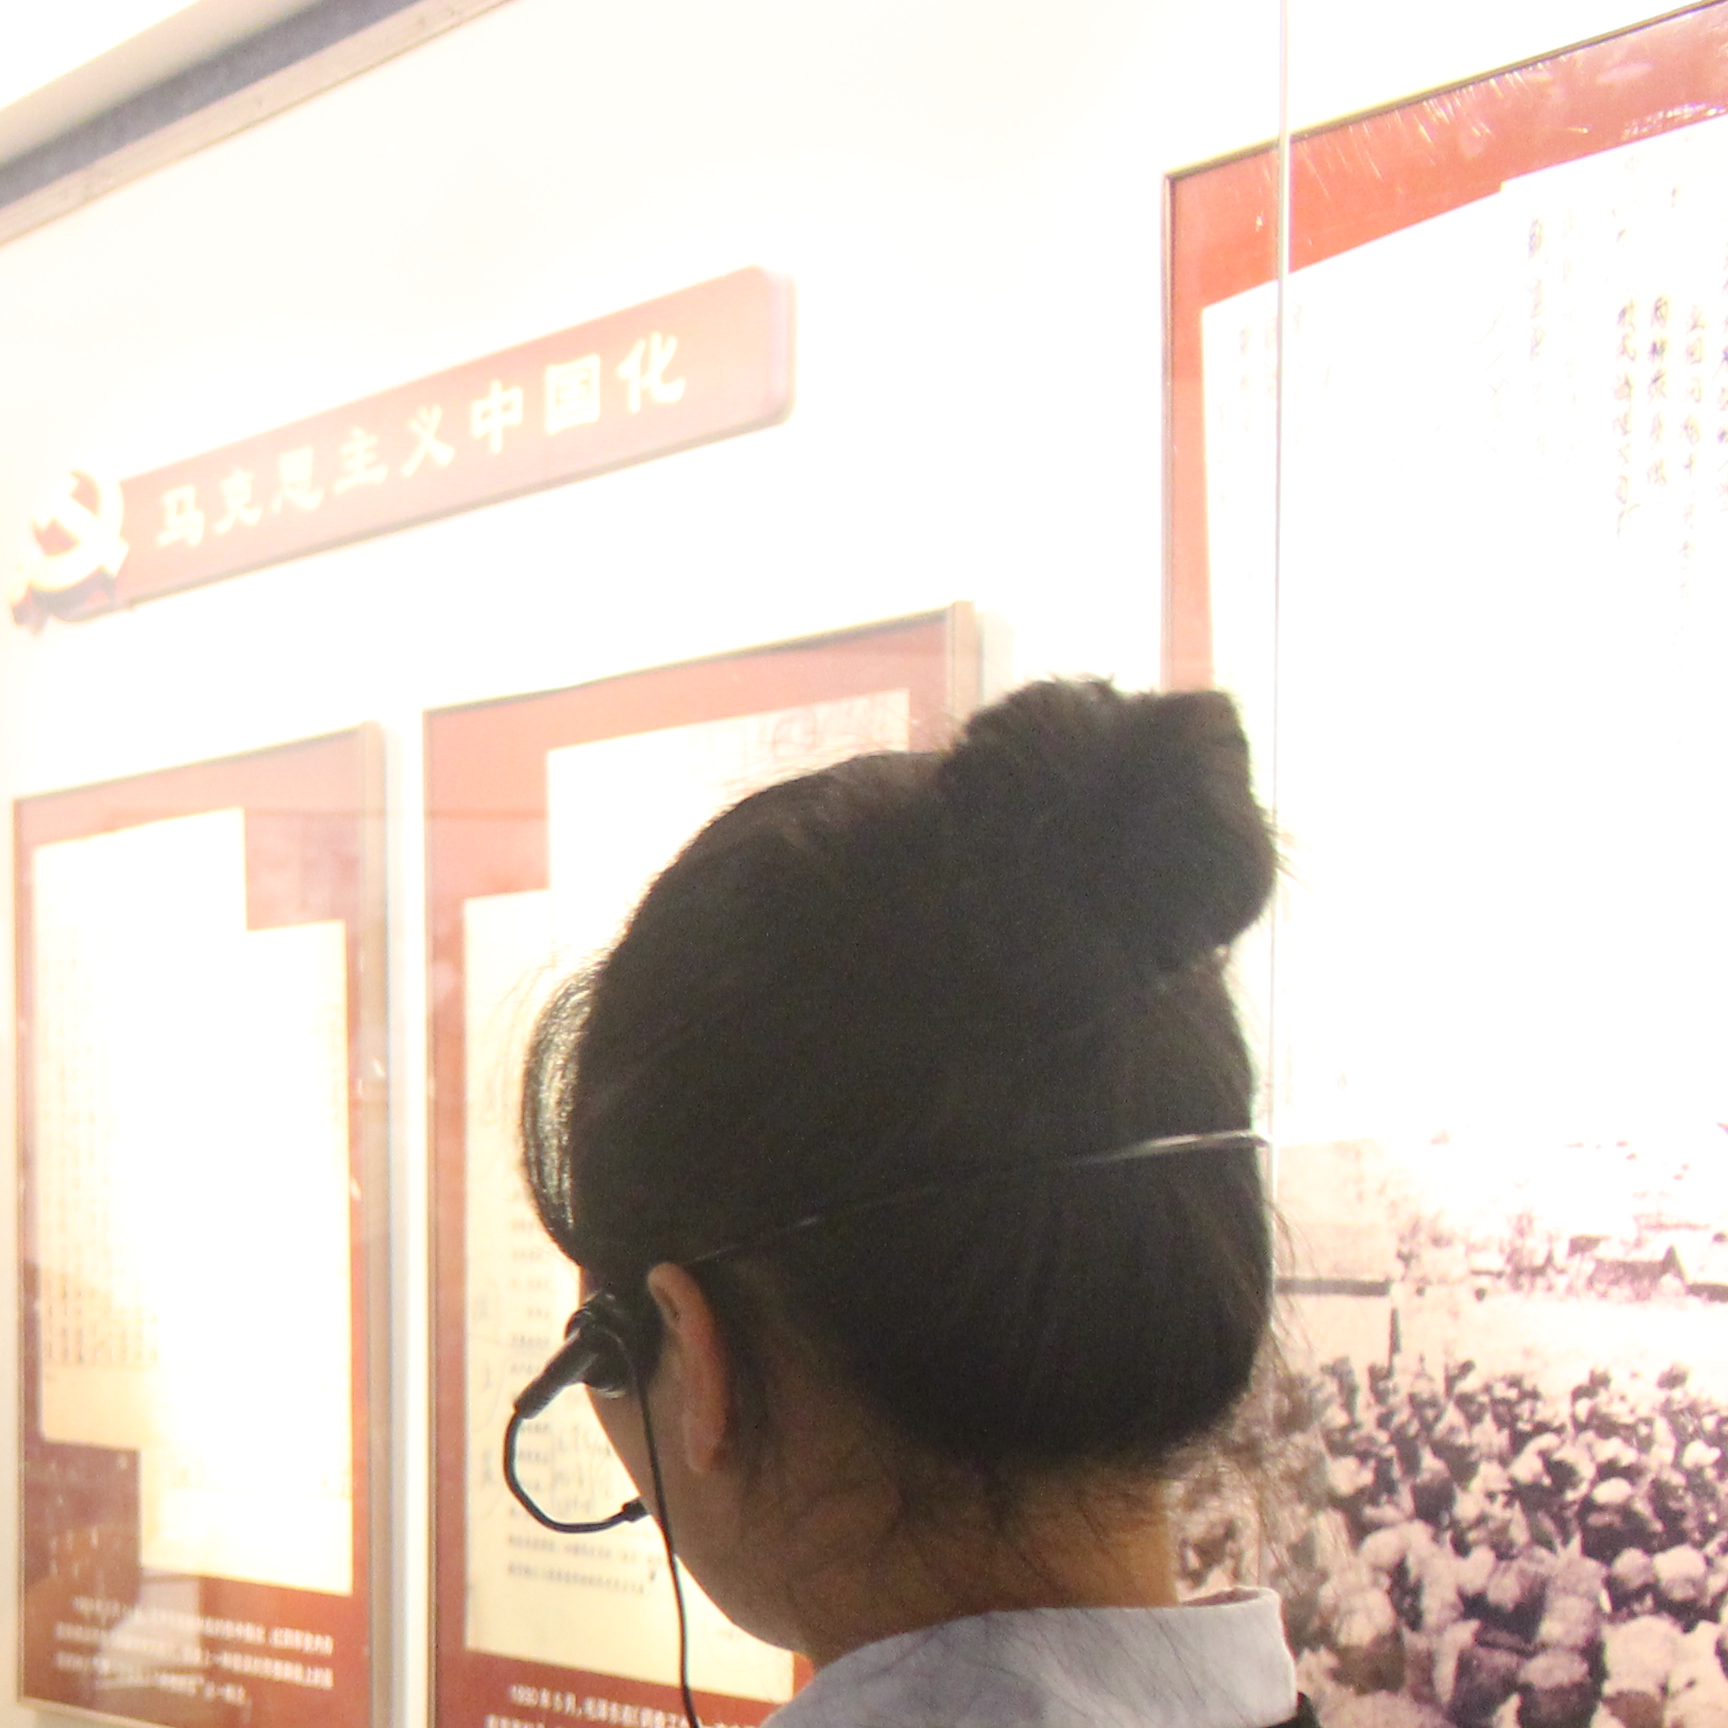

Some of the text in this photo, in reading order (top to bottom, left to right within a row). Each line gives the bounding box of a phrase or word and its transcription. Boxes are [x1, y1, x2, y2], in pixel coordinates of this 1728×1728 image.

[155, 331, 687, 549] 马克思主义中国化
